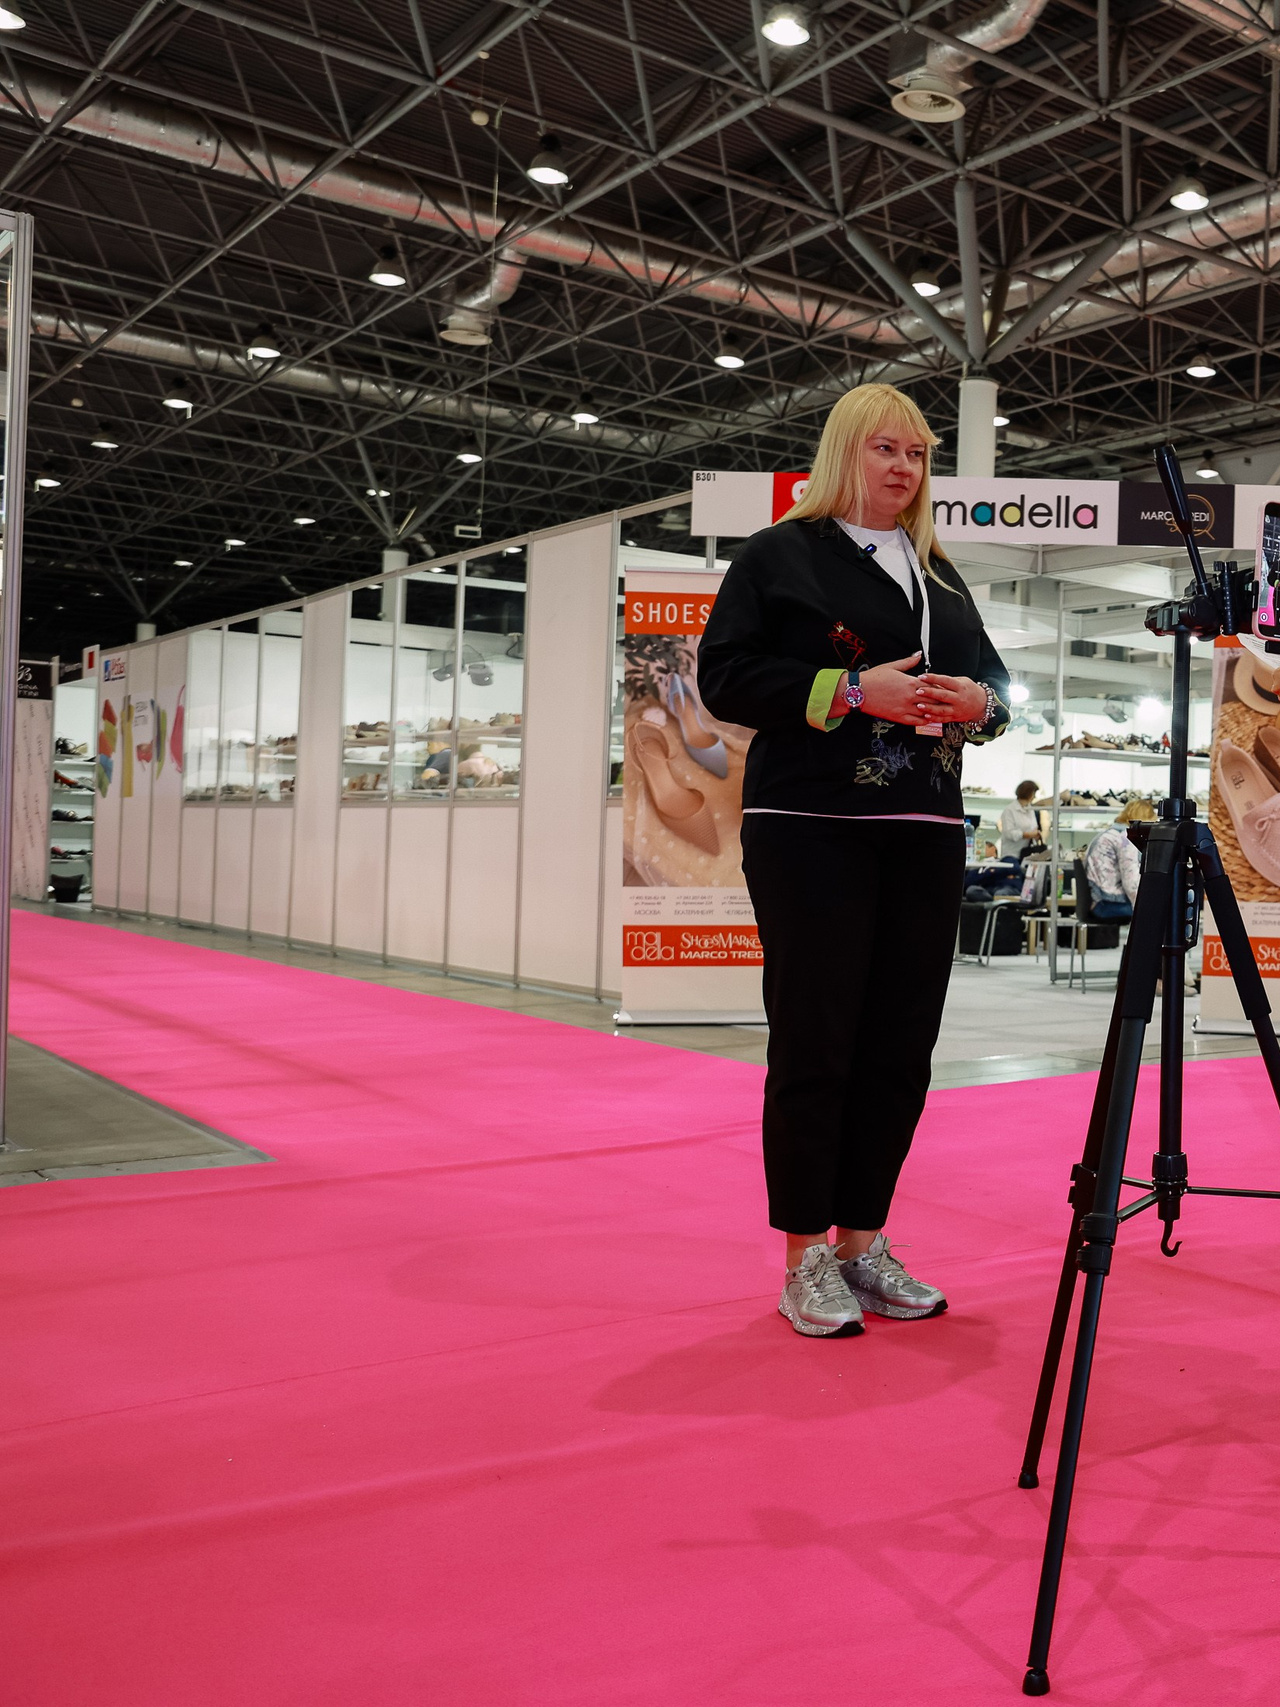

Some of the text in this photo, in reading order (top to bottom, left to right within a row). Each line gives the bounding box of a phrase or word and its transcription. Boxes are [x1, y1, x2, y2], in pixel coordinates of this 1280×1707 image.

[695, 472, 717, 482] B301
[932, 494, 1098, 529] madella
[1140, 511, 1174, 521] MARC
[681, 950, 764, 959] MARCO TRED
